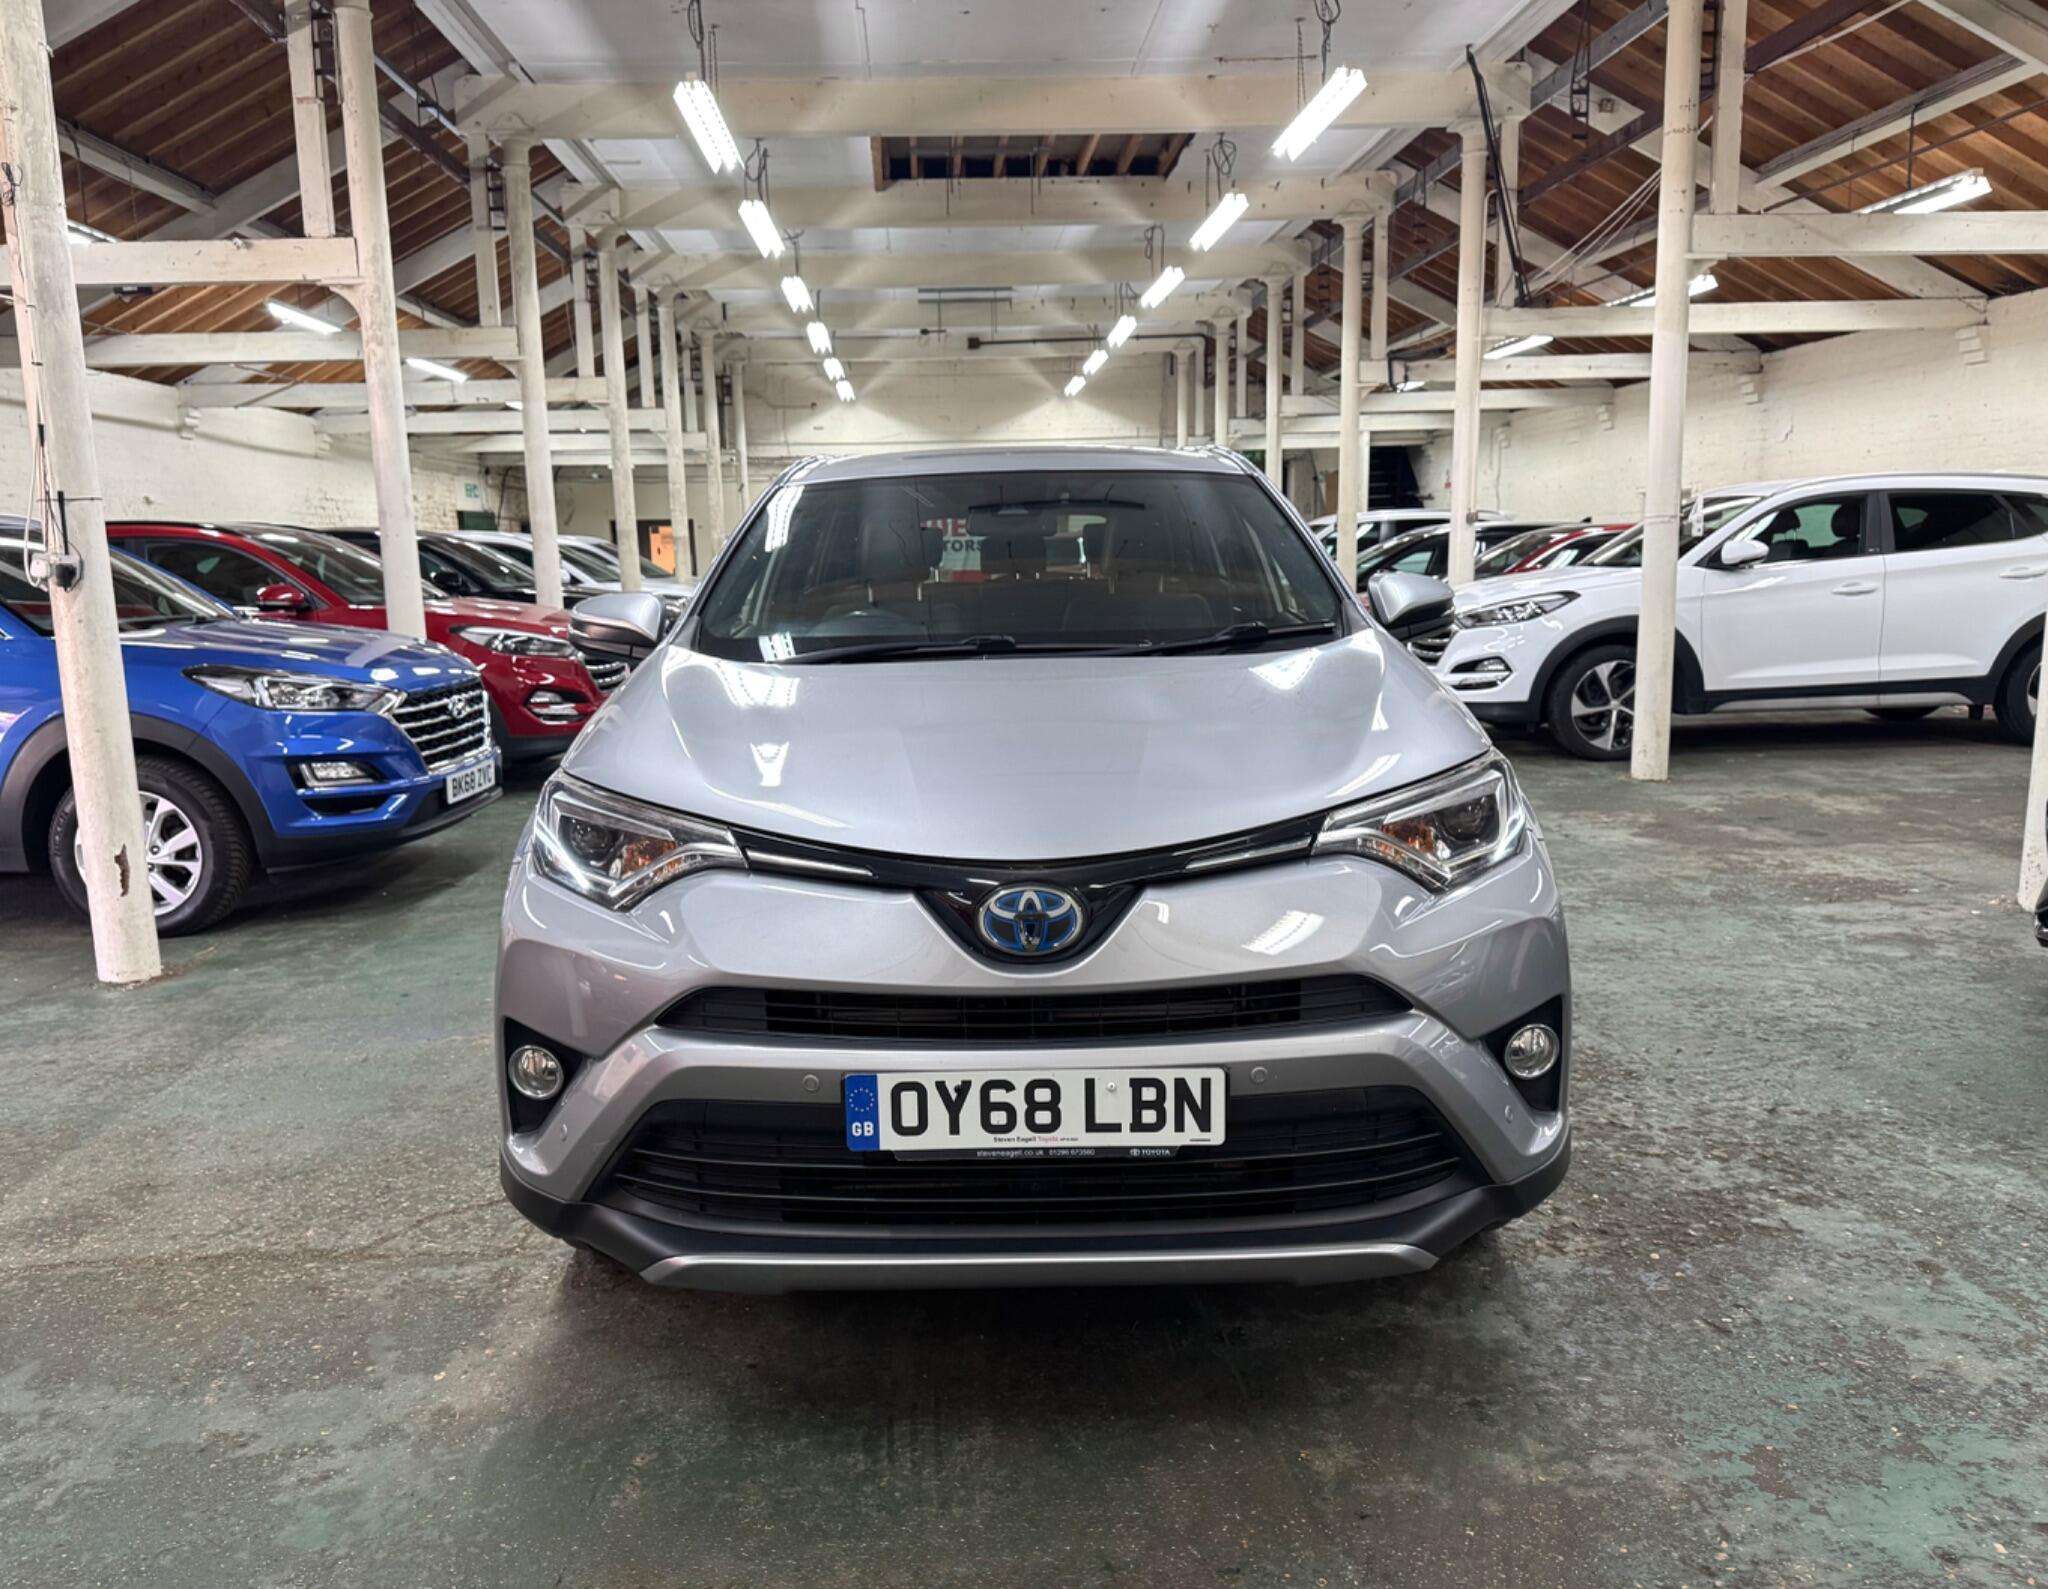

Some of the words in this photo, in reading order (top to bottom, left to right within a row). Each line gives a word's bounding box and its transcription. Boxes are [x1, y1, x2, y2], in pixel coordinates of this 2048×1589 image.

[890, 1078, 1062, 1137] OY68
[1084, 1077, 1212, 1134] LBN
[851, 1121, 874, 1136] GB
